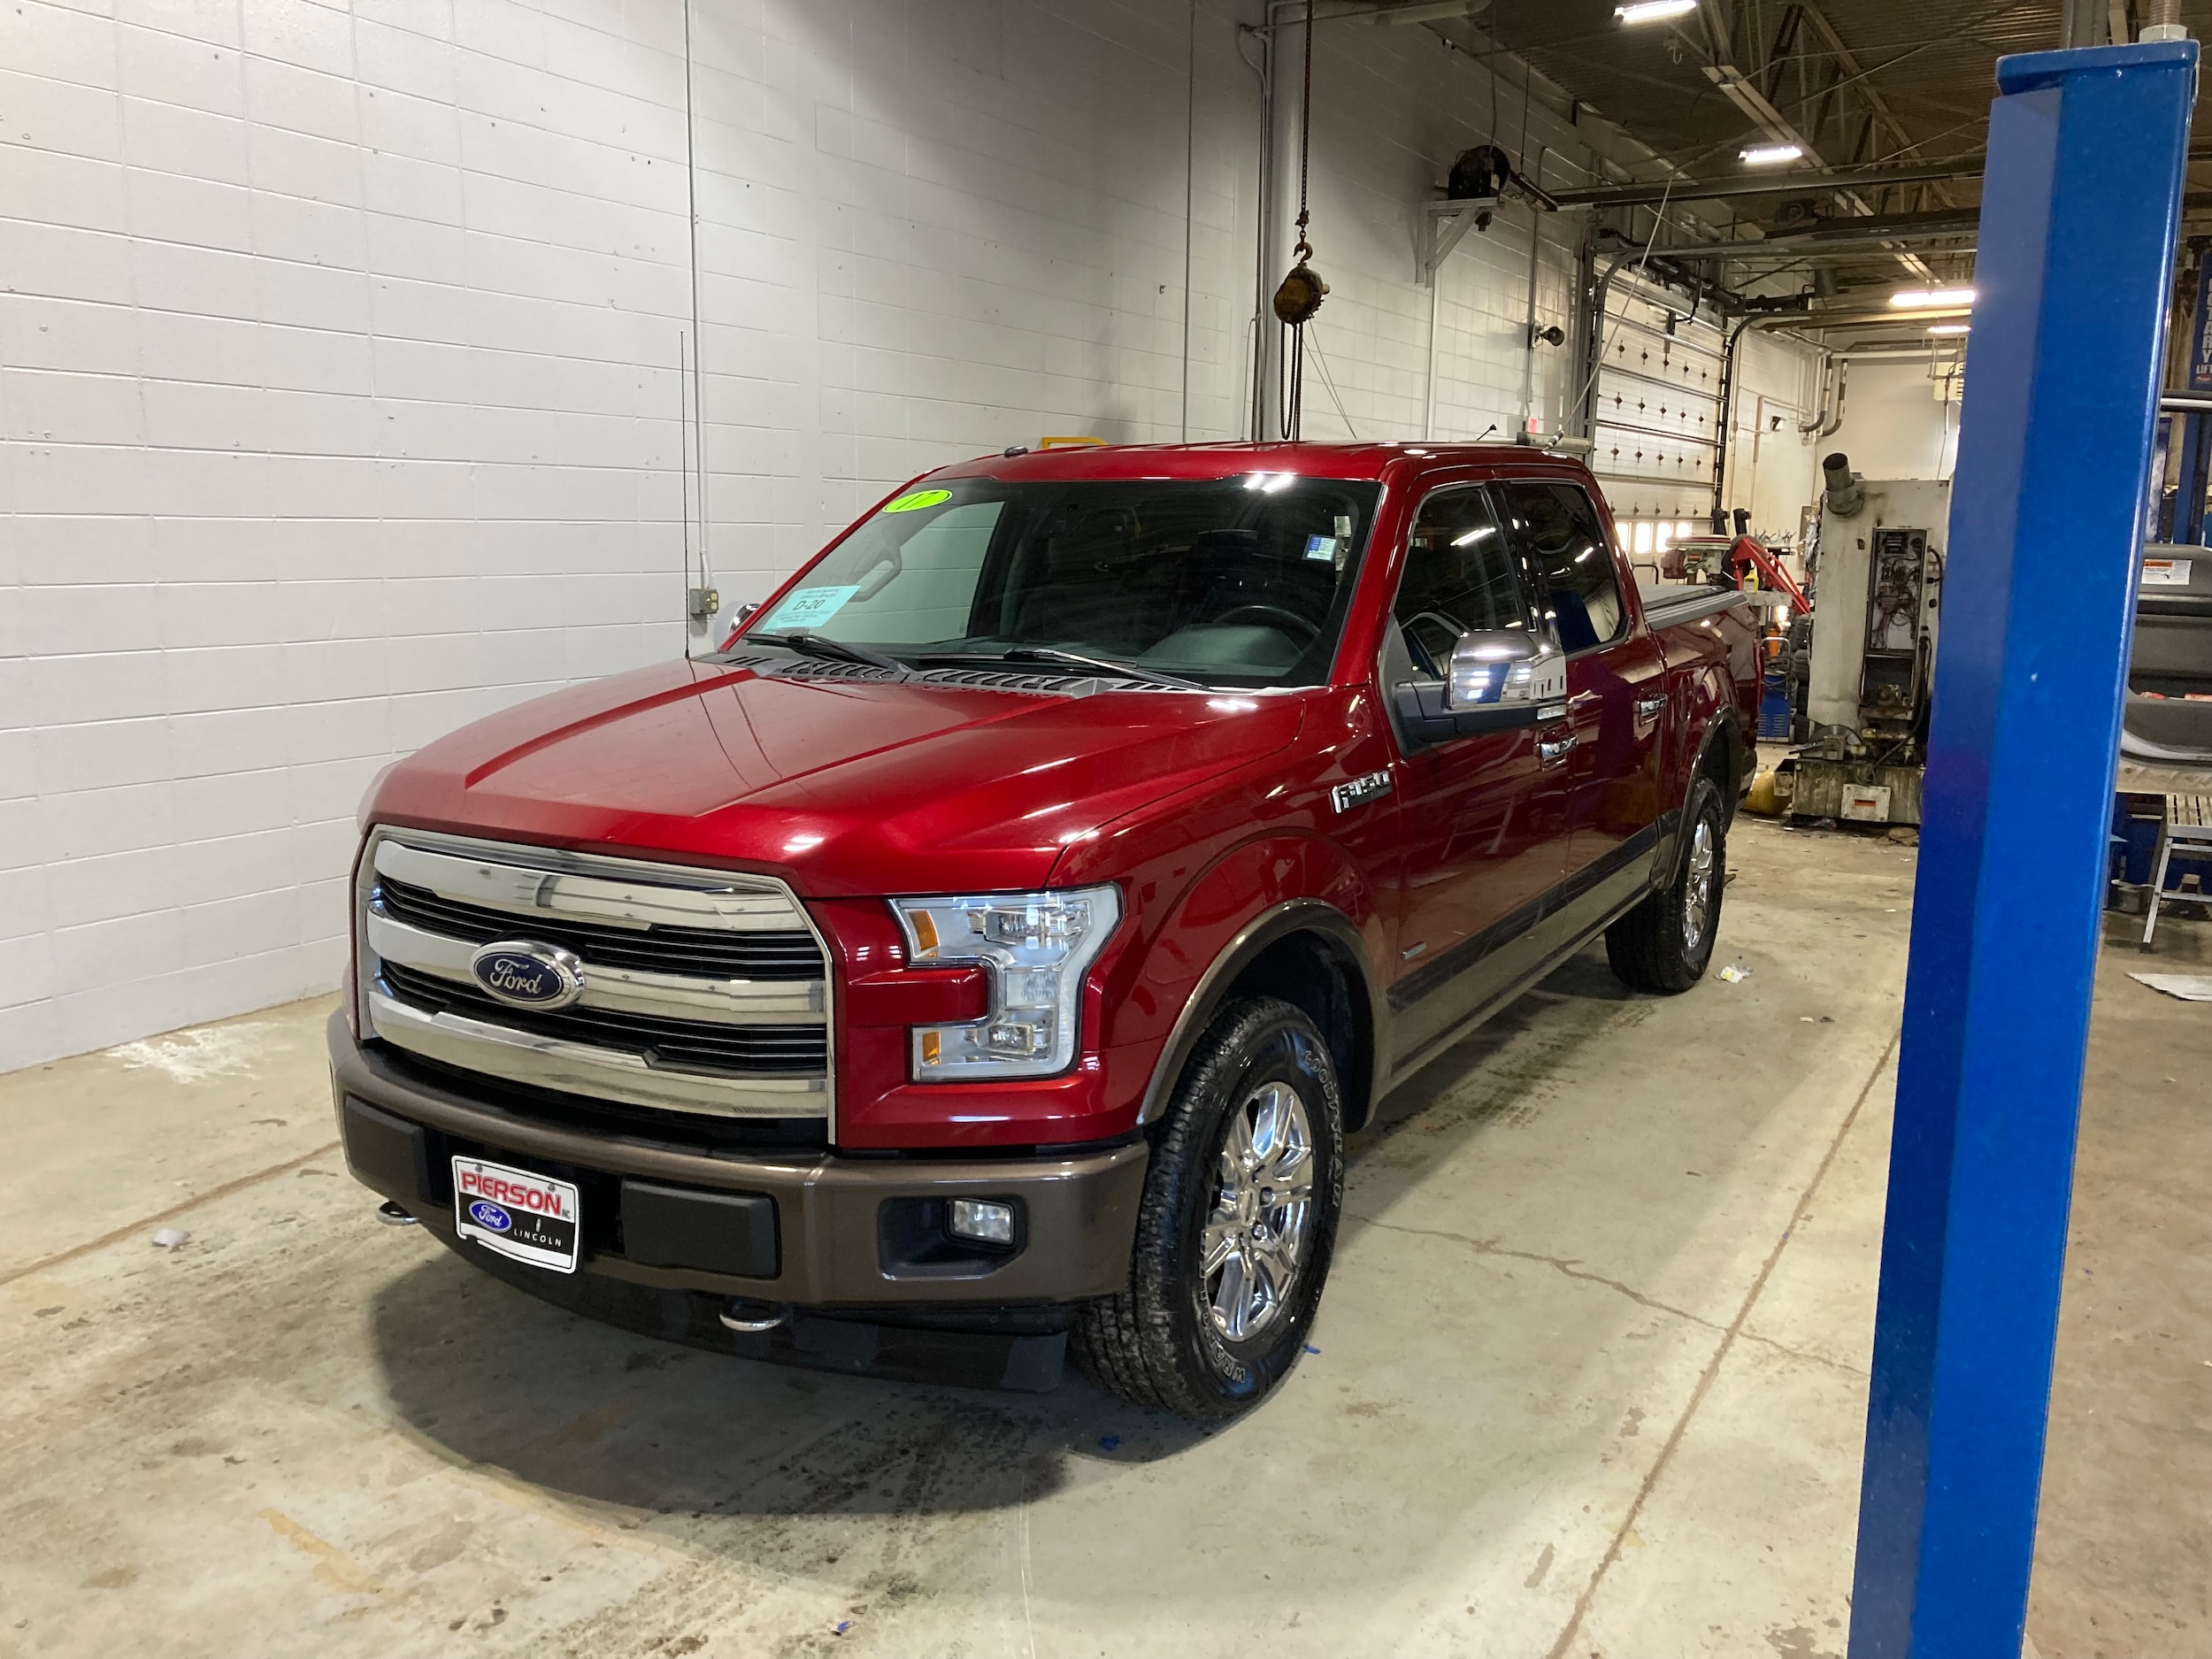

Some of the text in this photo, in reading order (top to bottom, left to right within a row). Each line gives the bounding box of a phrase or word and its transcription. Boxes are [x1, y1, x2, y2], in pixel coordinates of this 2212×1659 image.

[793, 599, 826, 611] D-20
[489, 958, 541, 994] Ford
[460, 1171, 562, 1217] PIERSON
[478, 1204, 502, 1227] Ford
[513, 1228, 561, 1247] LINCOLN
